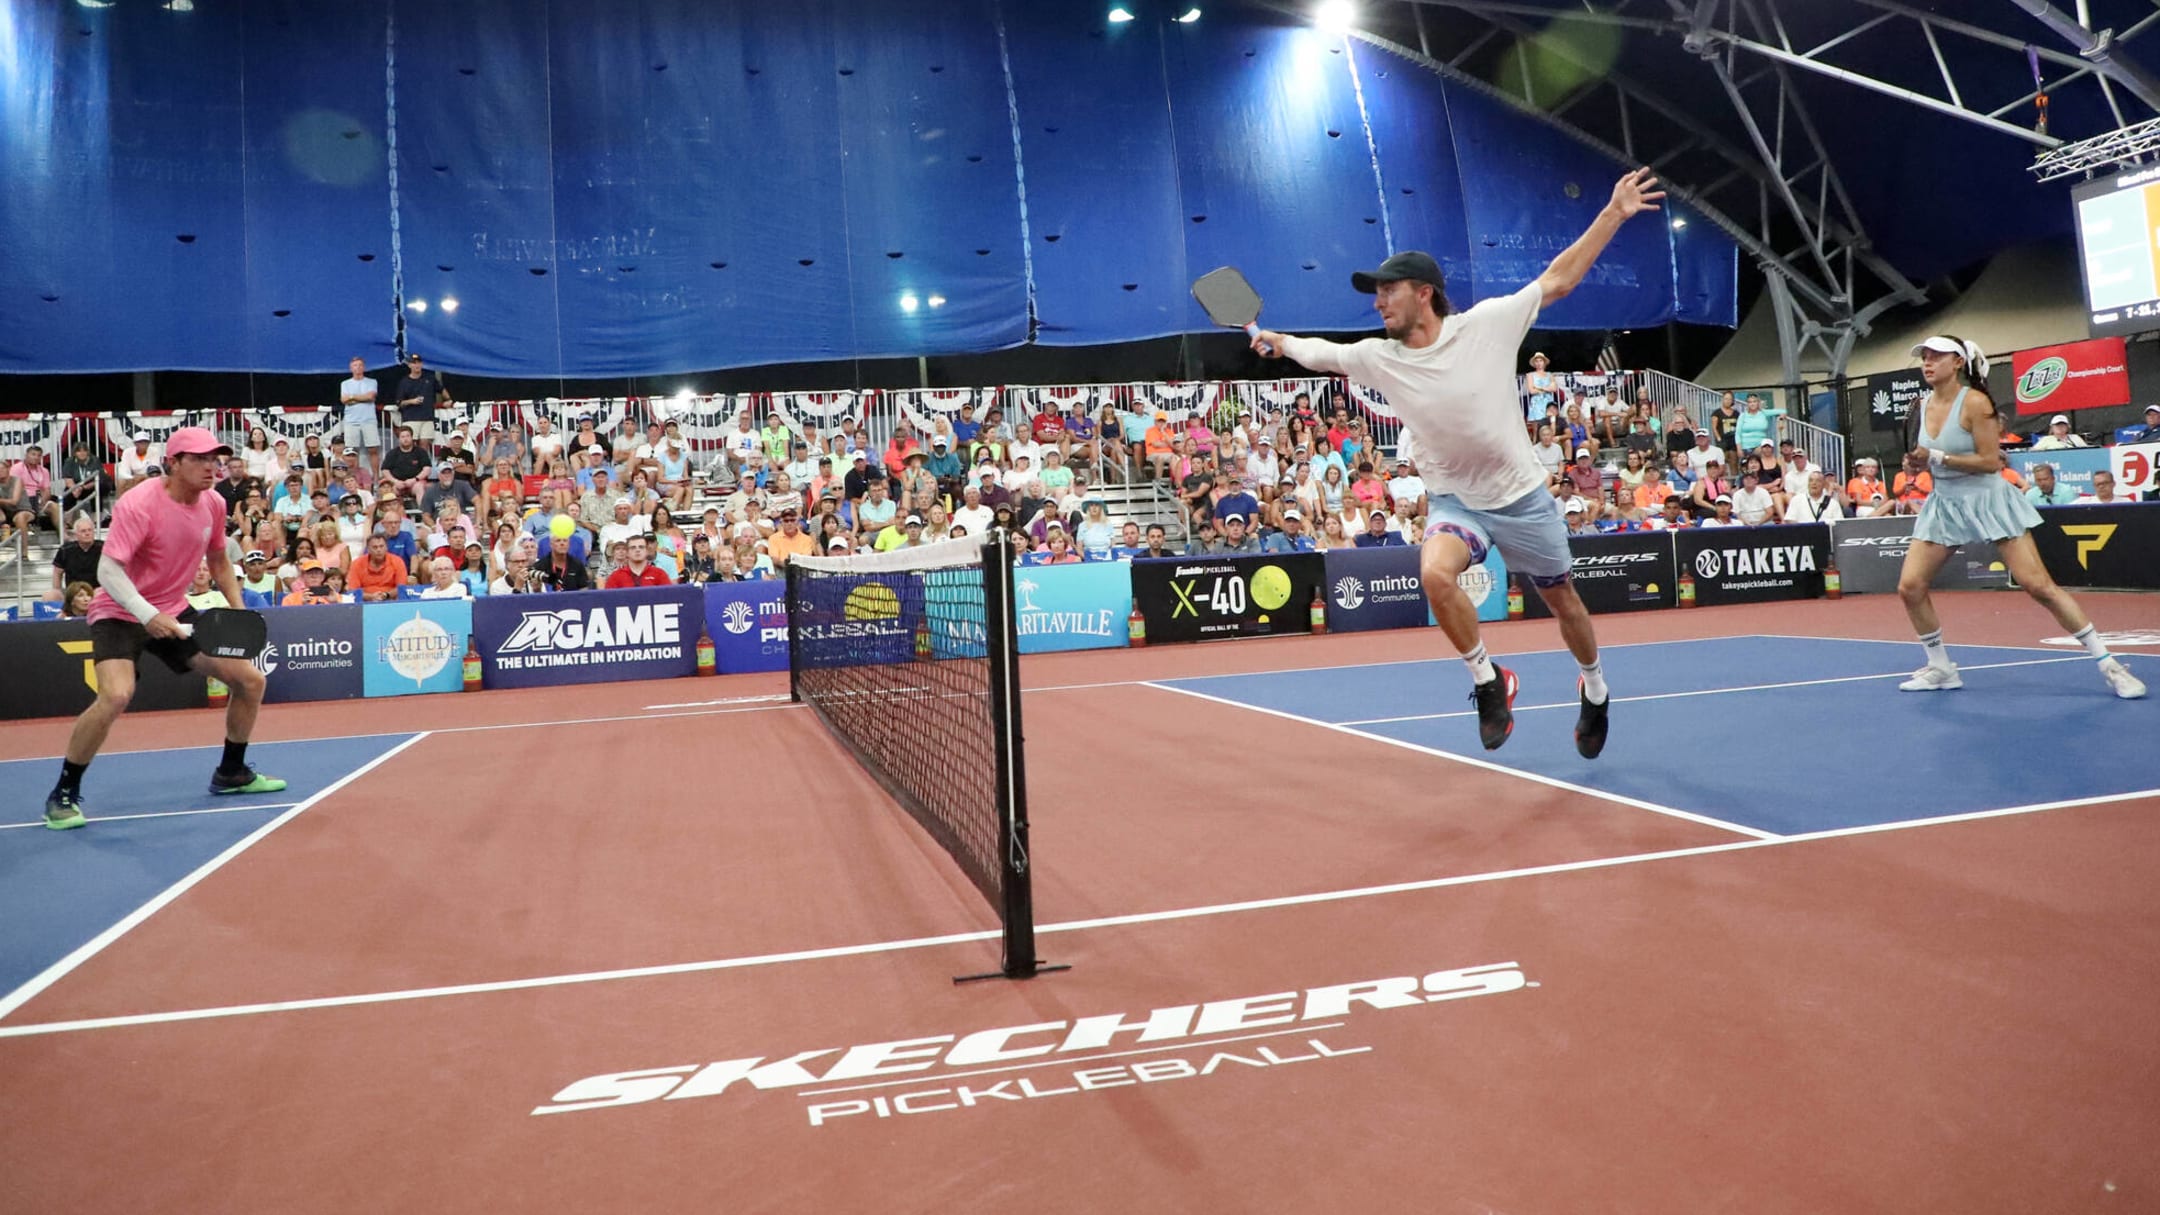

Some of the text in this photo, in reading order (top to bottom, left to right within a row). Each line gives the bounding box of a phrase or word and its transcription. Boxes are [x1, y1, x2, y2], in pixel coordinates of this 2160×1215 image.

[1892, 380, 1920, 391] Naples
[2060, 470, 2092, 482] Island
[1572, 552, 1659, 566] CHERS
[1723, 546, 1816, 576] TAKEYA
[1571, 569, 1628, 580] KLEBALL
[1370, 575, 1420, 592] minto
[1722, 579, 1793, 591] takeyapickleball.com
[1169, 575, 1247, 619] X-40
[1371, 592, 1421, 603] Communities
[287, 638, 353, 658] minto
[287, 658, 353, 670] Communities
[496, 647, 682, 670] THE ULTIMATE IN HYDRATION
[531, 961, 1526, 1116] SKECHERS
[807, 1038, 1372, 1126] PICKLEBALL
